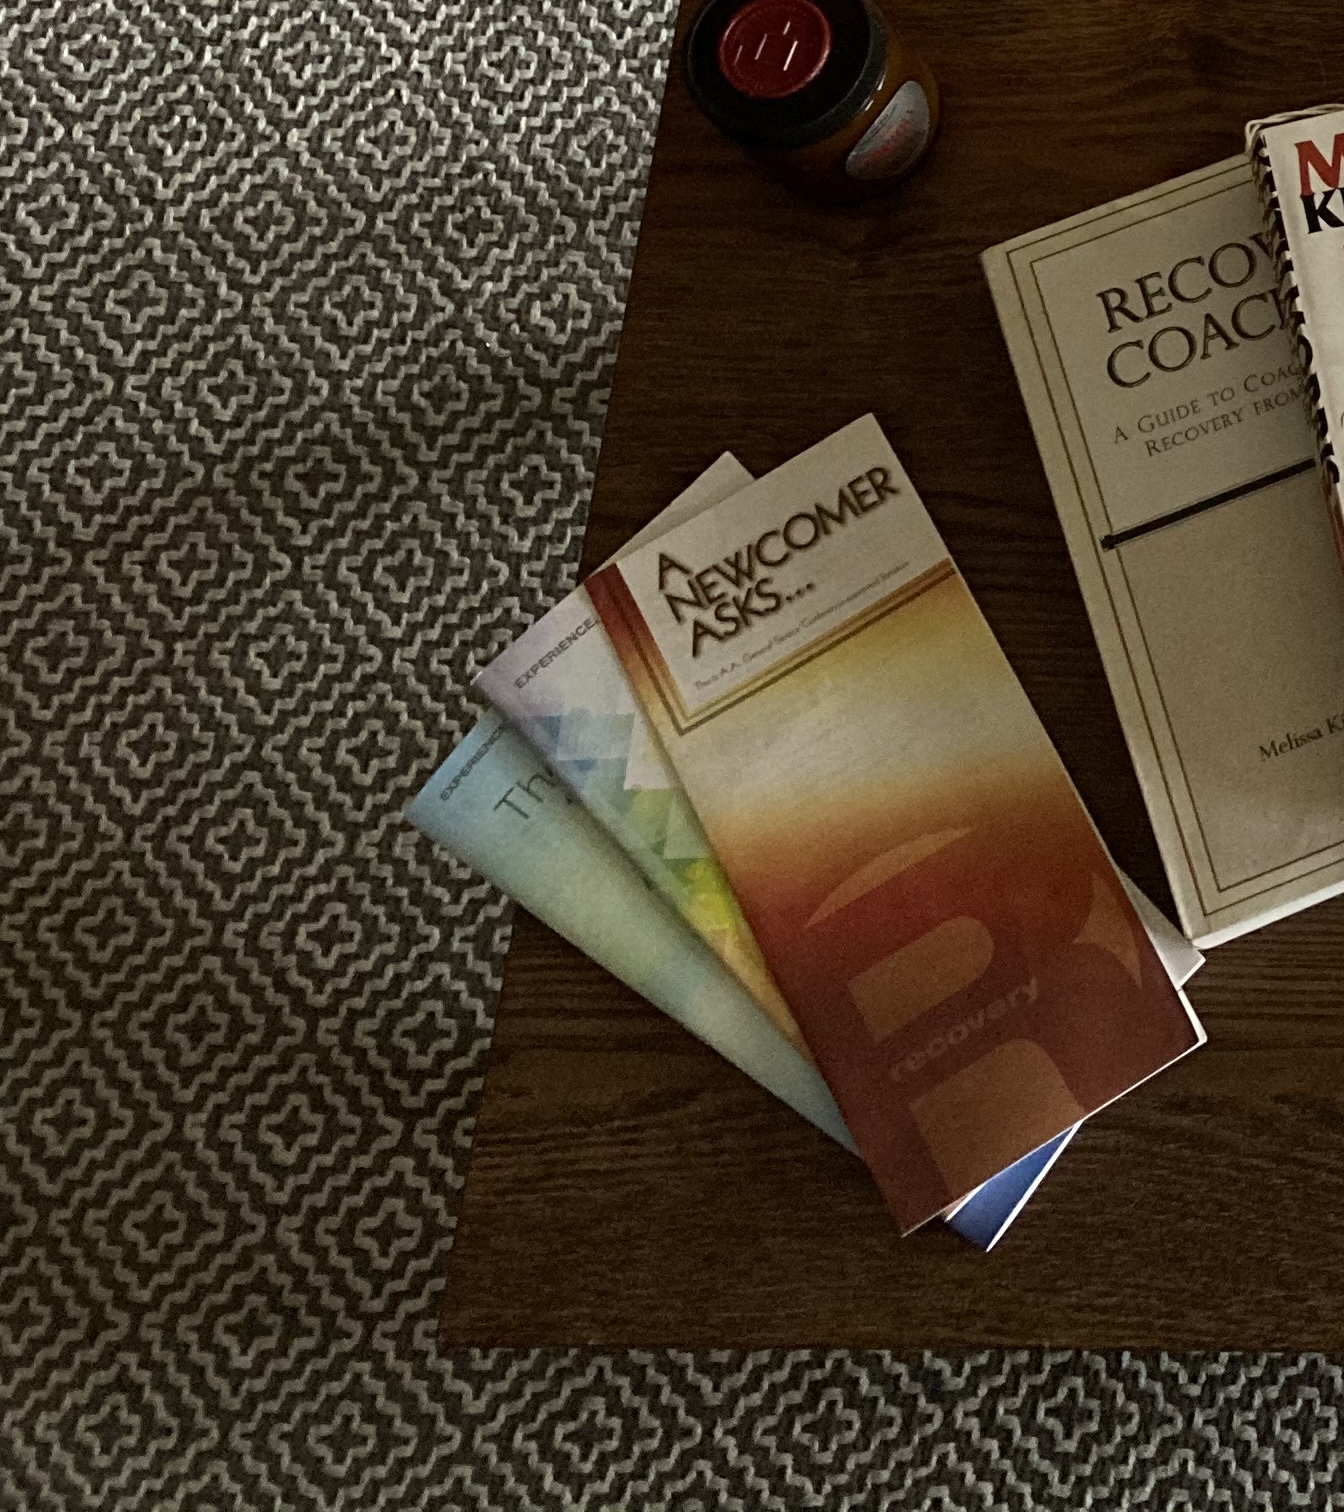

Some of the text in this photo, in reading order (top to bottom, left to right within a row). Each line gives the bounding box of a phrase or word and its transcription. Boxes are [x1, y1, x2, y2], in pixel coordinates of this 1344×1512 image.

[1096, 231, 1275, 334] RECOV
[1114, 359, 1303, 444] A GUIDE TO COAC
[1144, 408, 1244, 457] RECOVERY
[658, 551, 693, 591] A
[664, 466, 902, 625] NEWCOMER
[691, 576, 817, 658] ASKS...
[1258, 728, 1324, 762] Melissa
[890, 976, 1039, 1081] recovery
